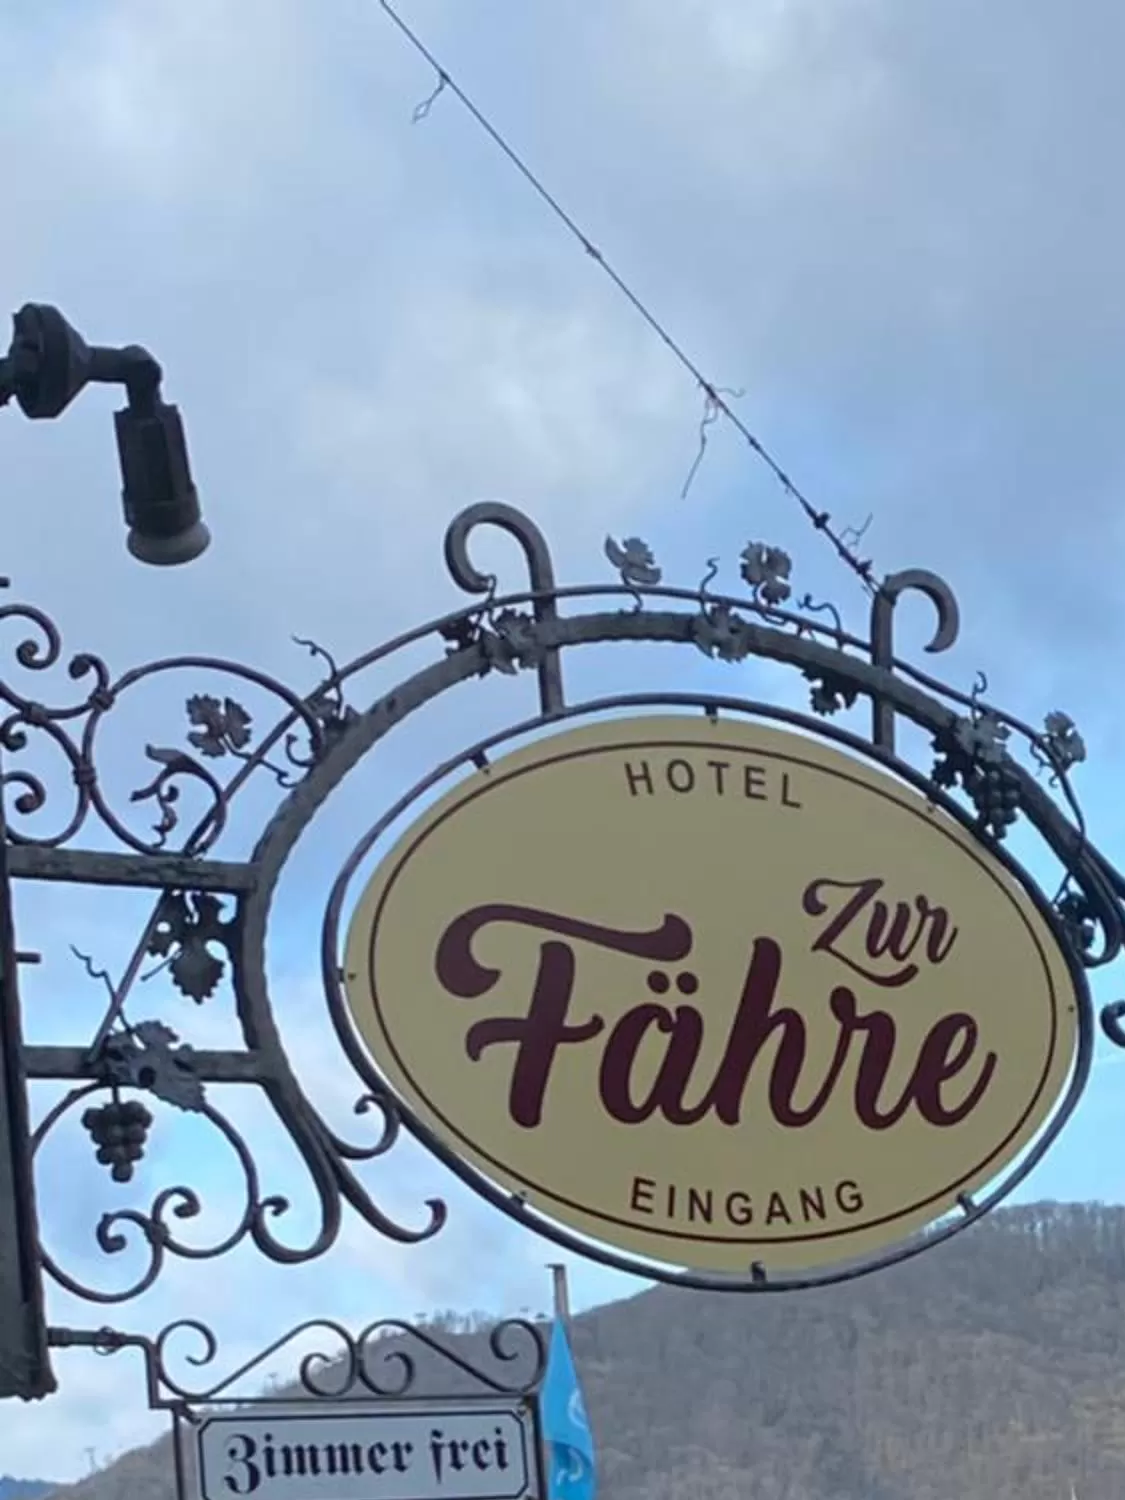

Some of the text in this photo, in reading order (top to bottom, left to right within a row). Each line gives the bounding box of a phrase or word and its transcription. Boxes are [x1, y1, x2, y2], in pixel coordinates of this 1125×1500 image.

[624, 759, 802, 809] HOTEL
[801, 878, 958, 987] Zur
[435, 904, 997, 1129] Fähre
[630, 1177, 864, 1226] EINGANG
[224, 1428, 508, 1494] Zimmer frei
